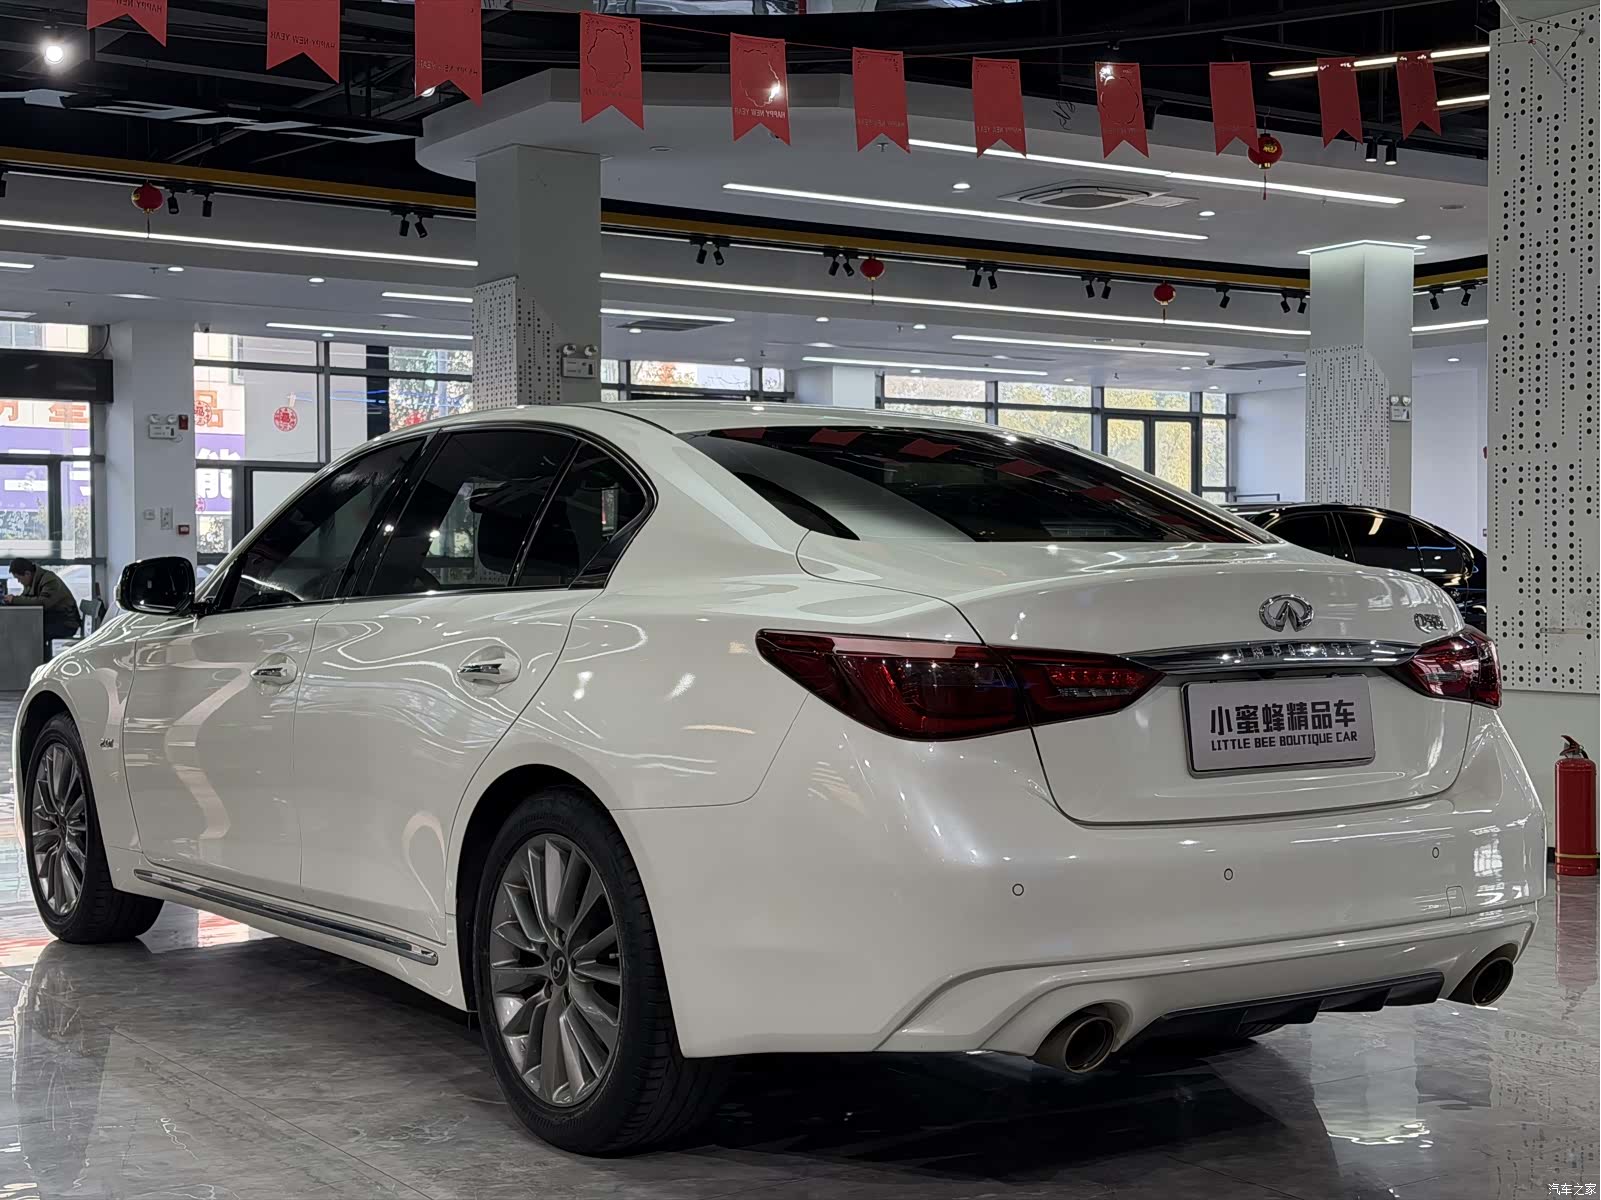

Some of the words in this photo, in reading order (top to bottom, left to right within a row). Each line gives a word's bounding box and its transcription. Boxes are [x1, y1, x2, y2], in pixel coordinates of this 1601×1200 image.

[1210, 699, 1356, 736] 小蜜蜂精品车
[1211, 738, 1251, 751] LITTLE
[1254, 736, 1276, 748] BEE
[1279, 732, 1333, 746] BOUTIQUE
[1336, 731, 1358, 742] CAR
